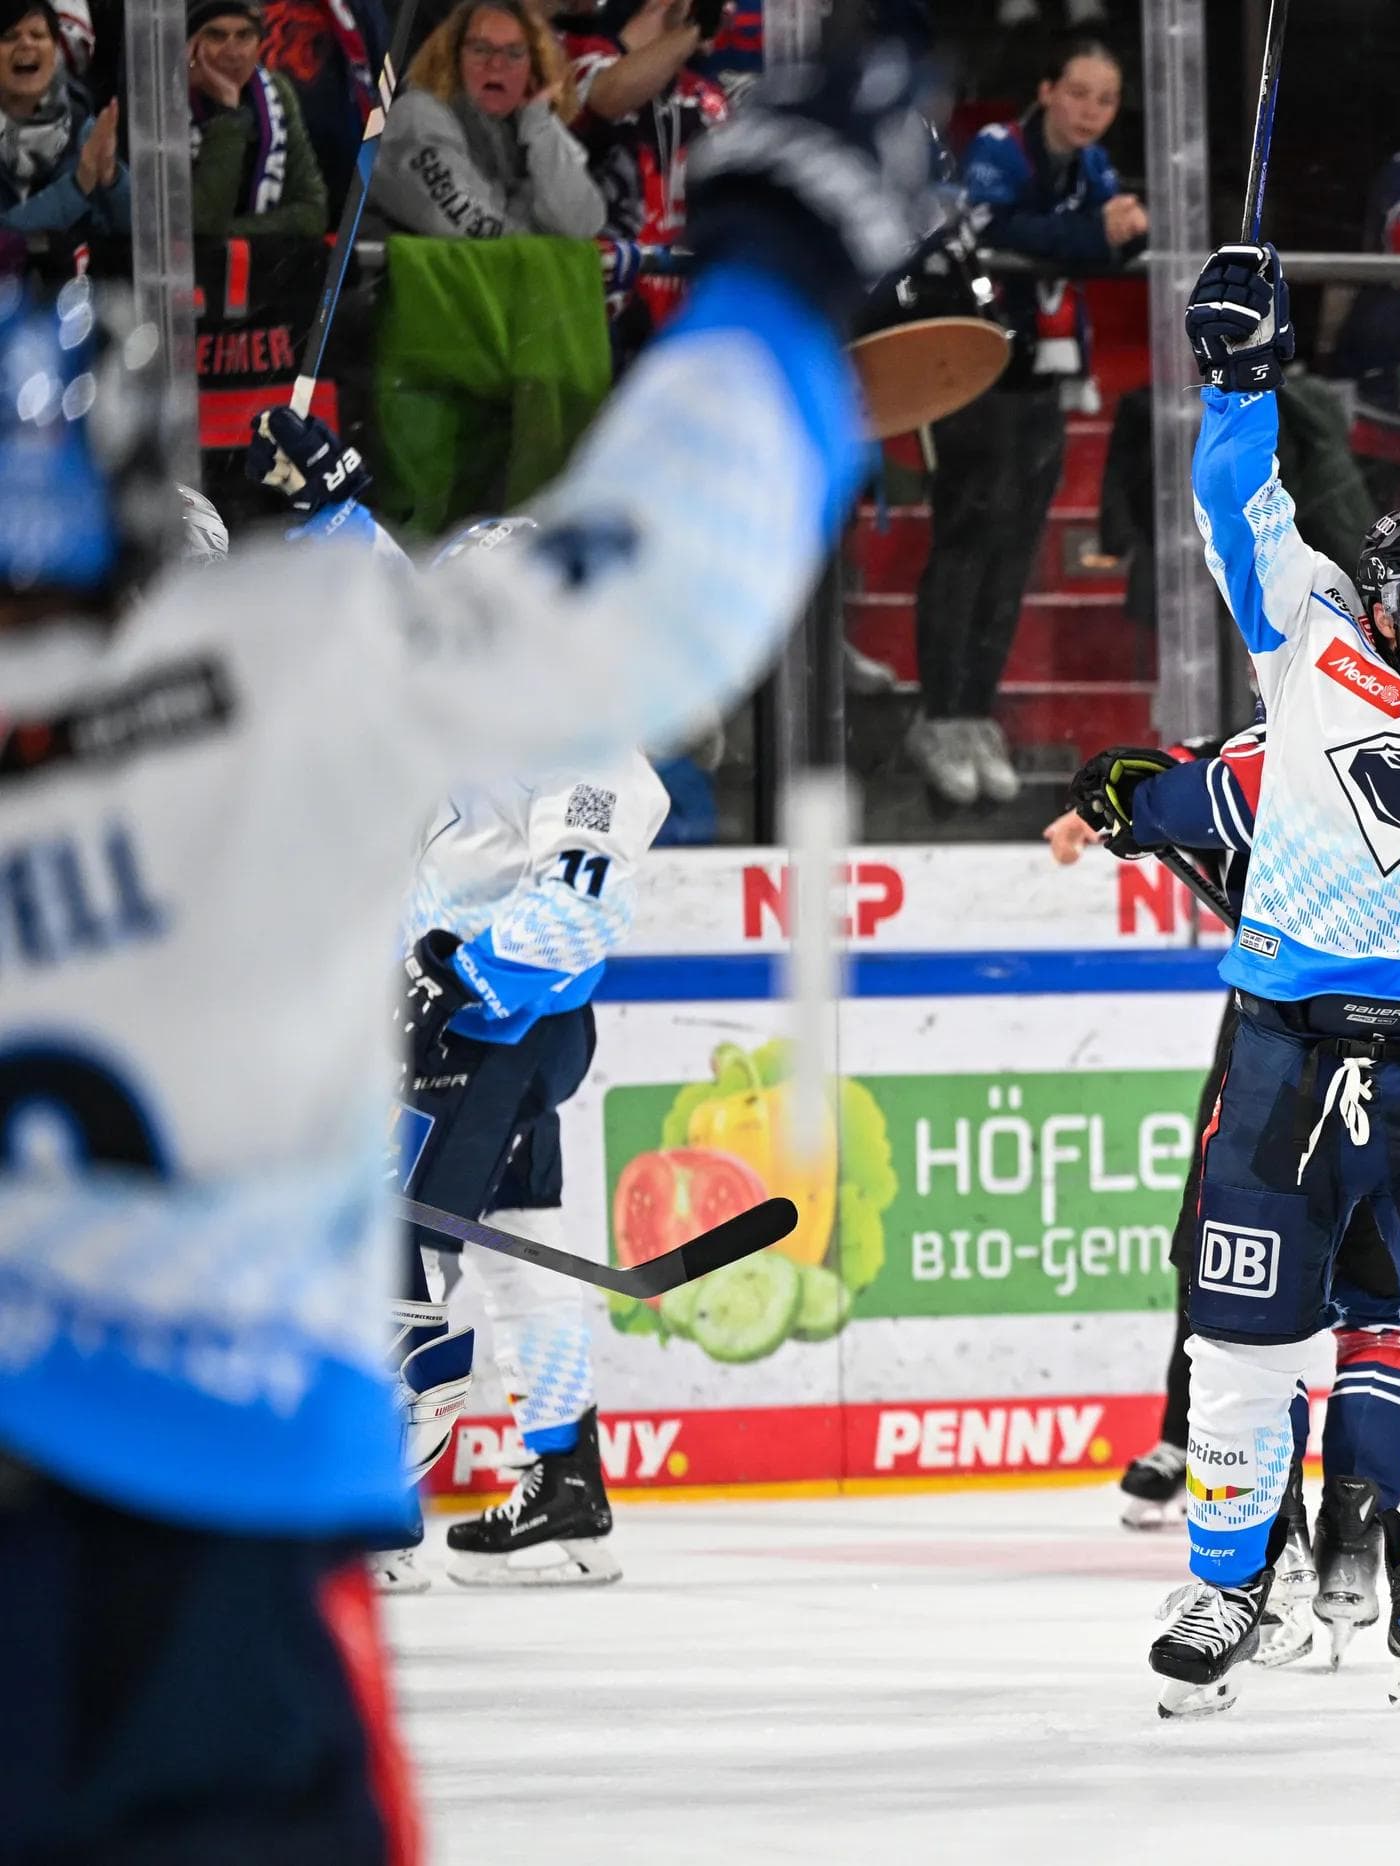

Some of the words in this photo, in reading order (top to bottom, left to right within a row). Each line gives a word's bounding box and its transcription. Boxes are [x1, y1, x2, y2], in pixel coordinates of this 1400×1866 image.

[558, 849, 612, 899] 11
[743, 863, 905, 940] NP
[1203, 1231, 1267, 1286] DB
